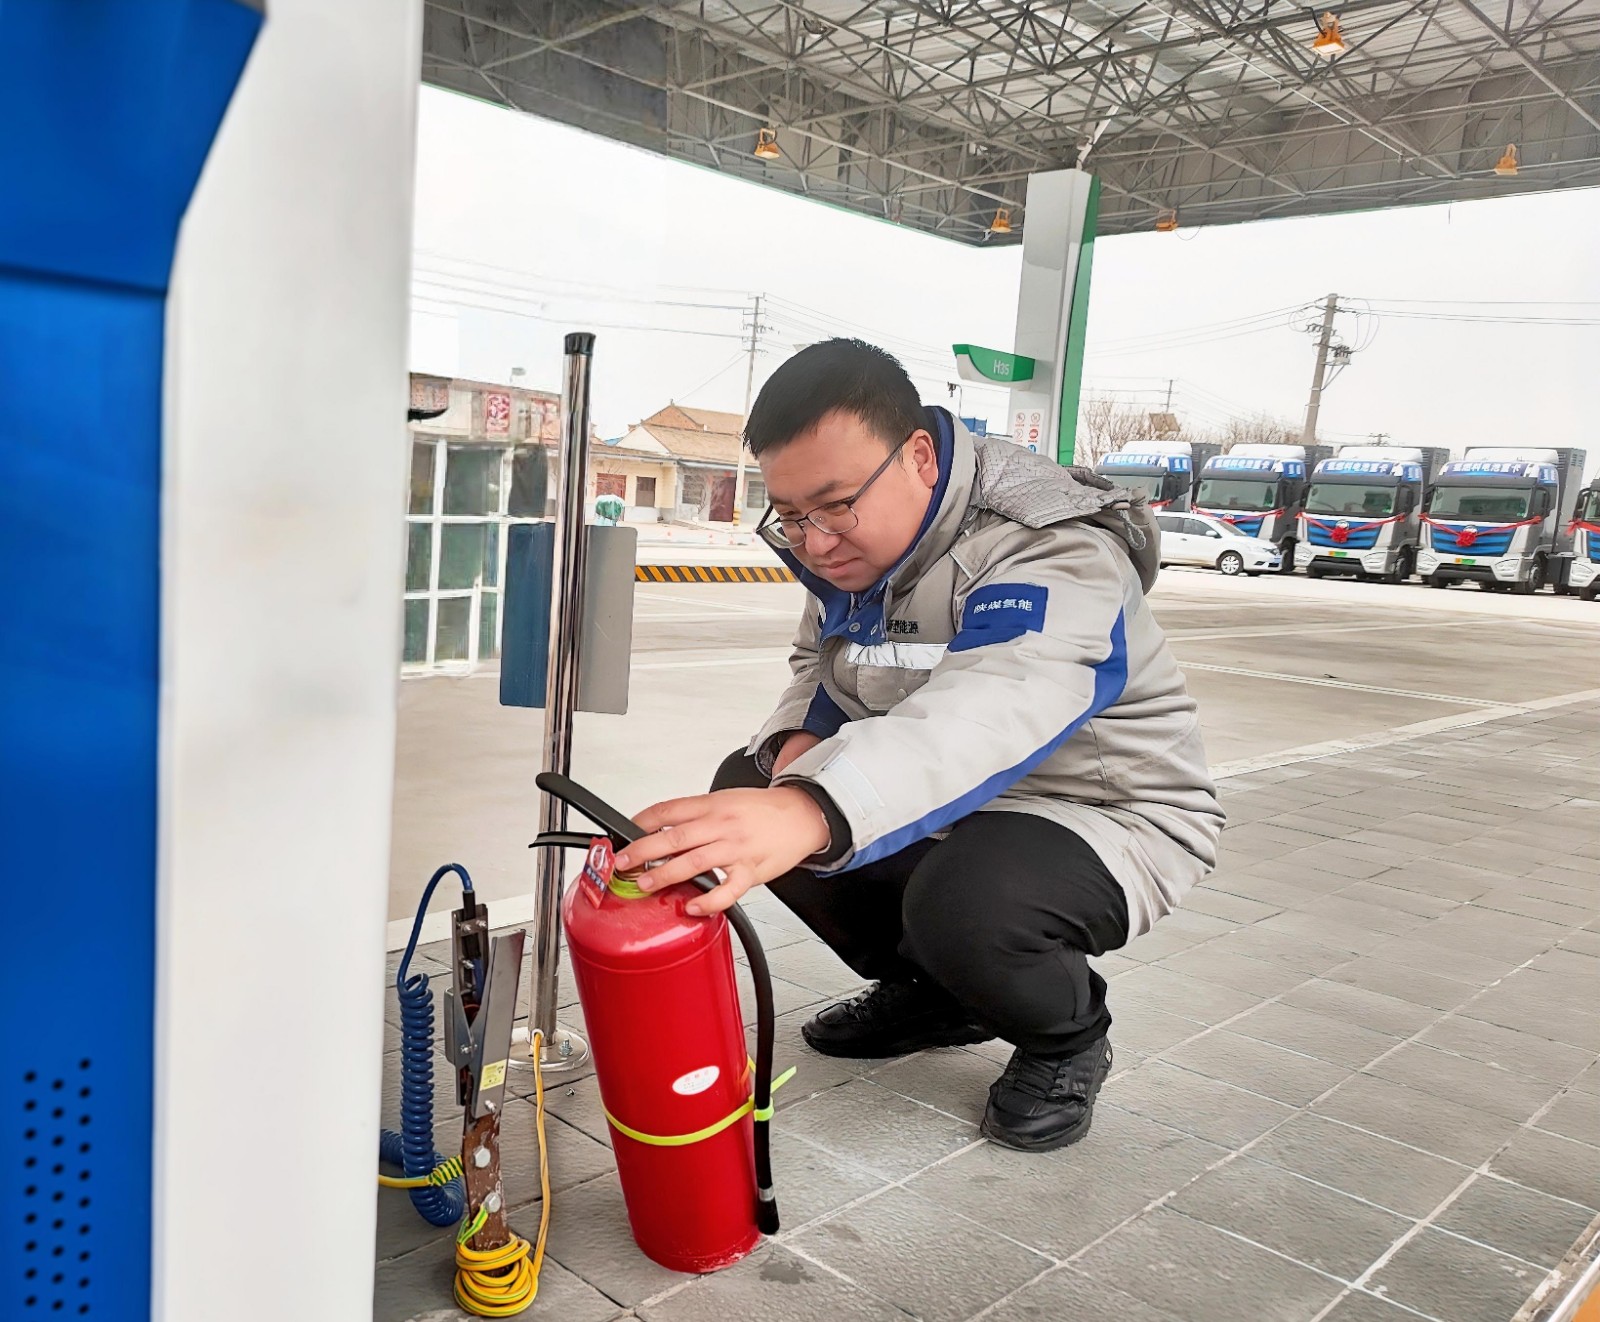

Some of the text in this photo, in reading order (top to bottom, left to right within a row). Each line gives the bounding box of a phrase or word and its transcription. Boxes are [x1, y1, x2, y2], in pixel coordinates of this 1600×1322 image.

[993, 359, 1010, 376] H35
[973, 598, 1033, 615] 陕煤氢能
